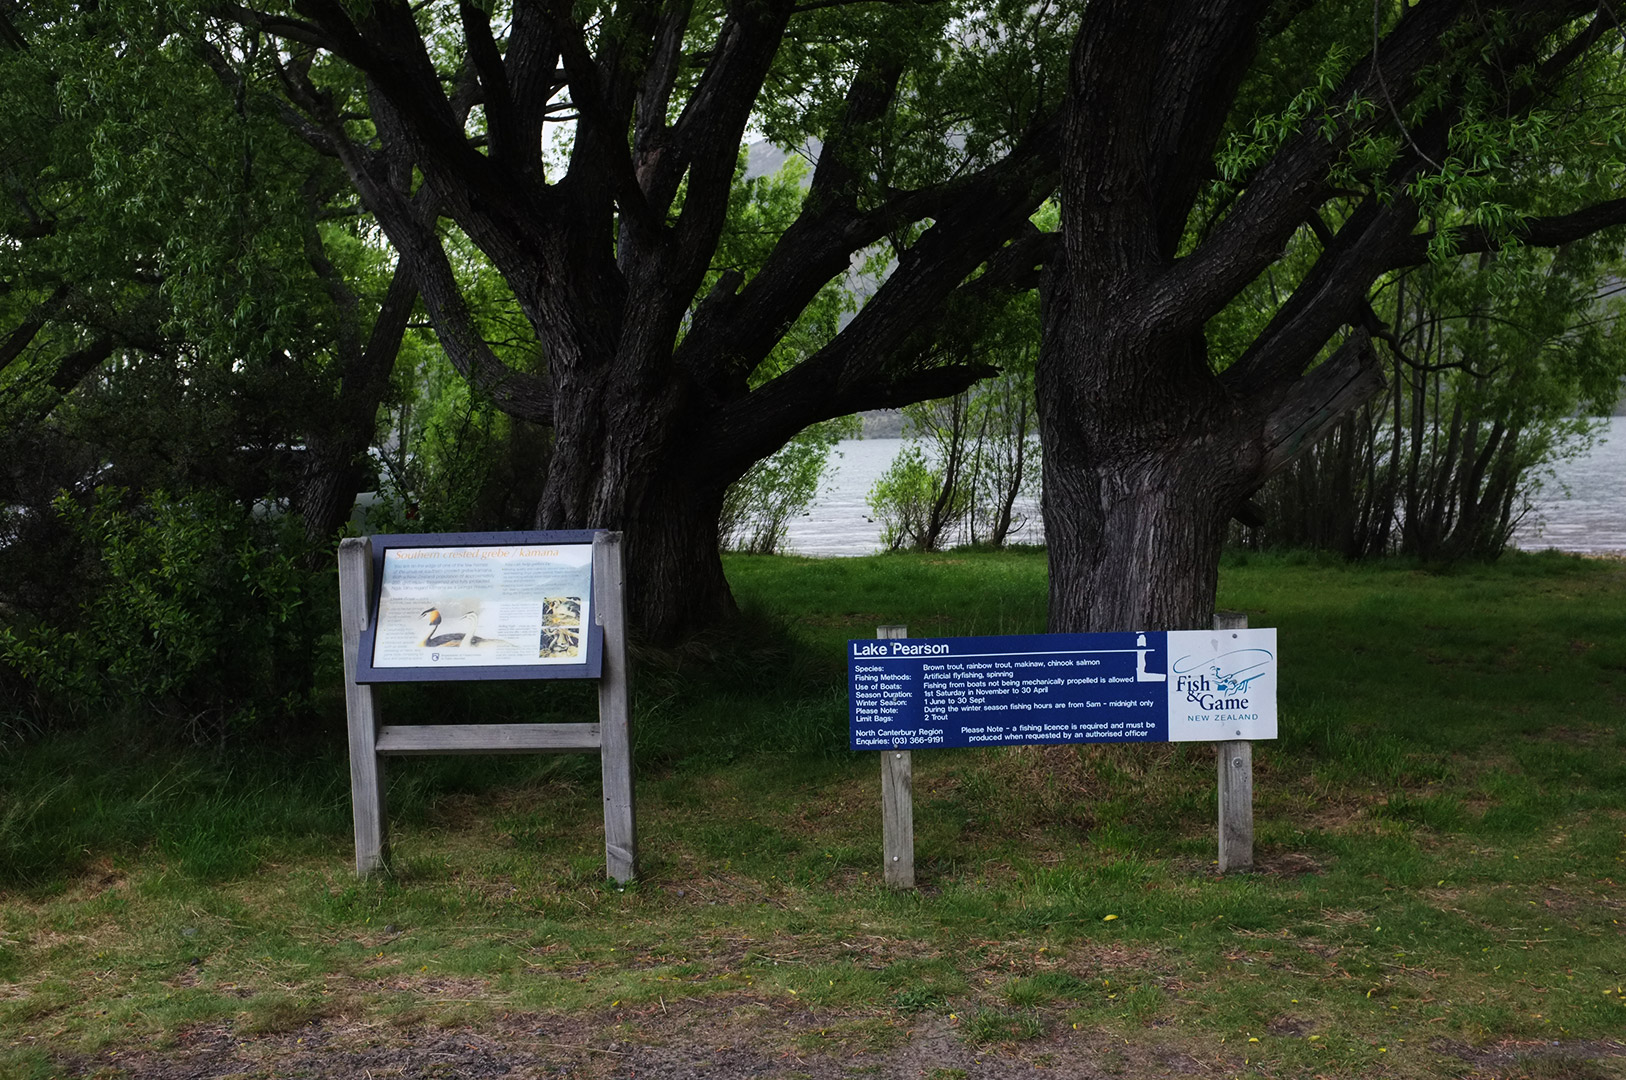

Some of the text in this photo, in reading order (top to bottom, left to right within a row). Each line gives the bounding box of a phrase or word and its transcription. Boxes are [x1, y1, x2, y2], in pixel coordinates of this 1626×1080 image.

[394, 550, 440, 560] Southern
[442, 549, 479, 559] crested
[481, 548, 510, 560] grebe
[854, 642, 949, 656] Lake Pearson
[855, 665, 885, 673] Species:
[923, 664, 945, 672] Brown
[947, 663, 965, 671] trout,
[967, 662, 993, 670] rainbow
[995, 661, 1013, 669] trout,
[1015, 660, 1047, 668] makinaw,
[1048, 659, 1074, 668] chinook
[855, 674, 879, 683] Fishing
[923, 671, 1014, 681] Artificial flyfishing, spinning
[871, 683, 879, 691] of
[923, 682, 948, 691] Fishing
[1002, 679, 1021, 688] being
[1022, 678, 1065, 687] mechanically
[1067, 677, 1099, 686] propelled
[1176, 675, 1210, 691] Fish
[883, 691, 913, 699] Duration:
[936, 689, 966, 698] Saturday
[976, 688, 1011, 696] November
[1033, 686, 1049, 695] April
[880, 699, 908, 707] Season:
[957, 697, 968, 705] 30
[969, 697, 986, 705] Sept
[1187, 691, 1249, 710] & Game
[880, 707, 899, 715] Note:
[924, 706, 946, 714] During
[948, 705, 959, 713] the
[1010, 703, 1032, 711] fishing
[1034, 702, 1053, 710] hours
[1068, 701, 1085, 709] from
[1109, 700, 1138, 709] midnight
[1140, 700, 1155, 708] only
[874, 715, 894, 724] Bags:
[1215, 713, 1258, 721] ZEALAND
[1020, 725, 1042, 733] fishing
[1044, 723, 1070, 731] licence
[1071, 723, 1078, 731] is
[1080, 722, 1109, 731] required
[878, 729, 917, 738] Canterbury
[919, 728, 944, 737] Region
[969, 734, 1003, 743] produced
[1005, 733, 1024, 741] when
[1026, 732, 1061, 741] requested
[1063, 731, 1073, 740] by
[1086, 730, 1123, 738] authorised
[1125, 730, 1149, 738] officer
[856, 738, 891, 746] Enquiries:
[892, 737, 908, 746] (03)
